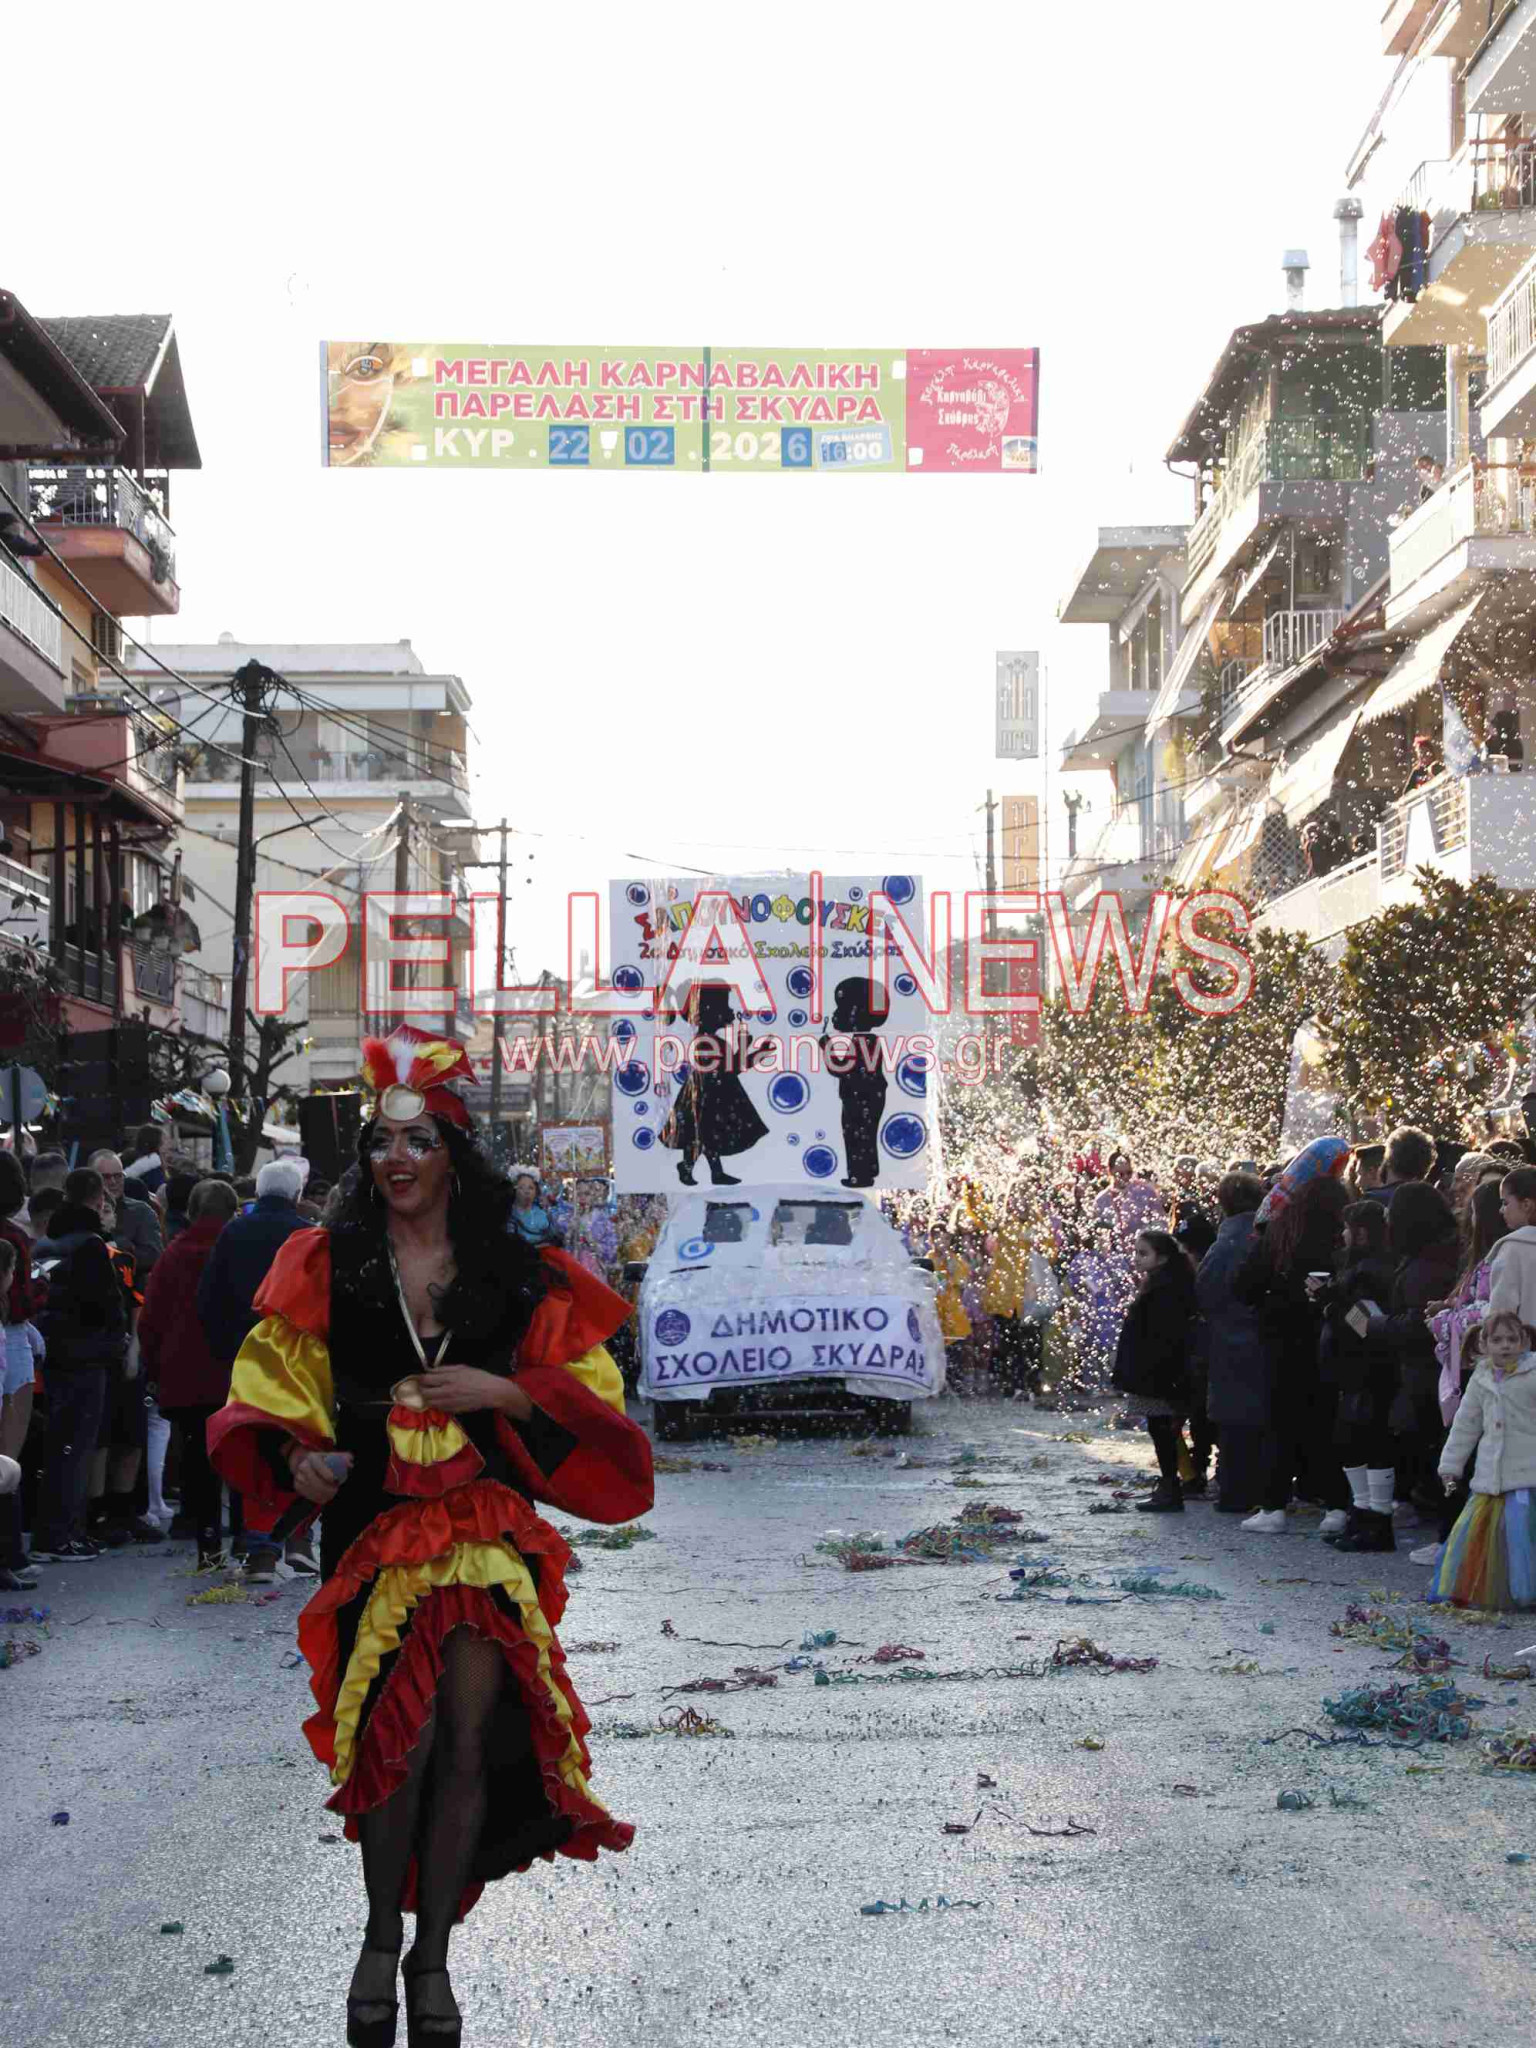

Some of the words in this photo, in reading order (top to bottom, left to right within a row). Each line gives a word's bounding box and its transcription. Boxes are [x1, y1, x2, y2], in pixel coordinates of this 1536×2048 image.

[433, 358, 586, 387] ΜΕΓΑΛΗ
[599, 360, 880, 390] ΚΑΡΝΑΒΑΛΙΚΗ
[433, 390, 640, 422] ΠΑΡΕΛΑΣΗ
[652, 393, 726, 423] ΣΤΗ
[735, 395, 883, 424] ΣΚΥΔΡΑ
[710, 430, 809, 463] 2026
[830, 939, 905, 960] Σκύδρας
[710, 1307, 889, 1338] ΔΗΜΟΤΙΚΟ
[655, 1346, 792, 1381] ΣΧΟΛΕΙΟ
